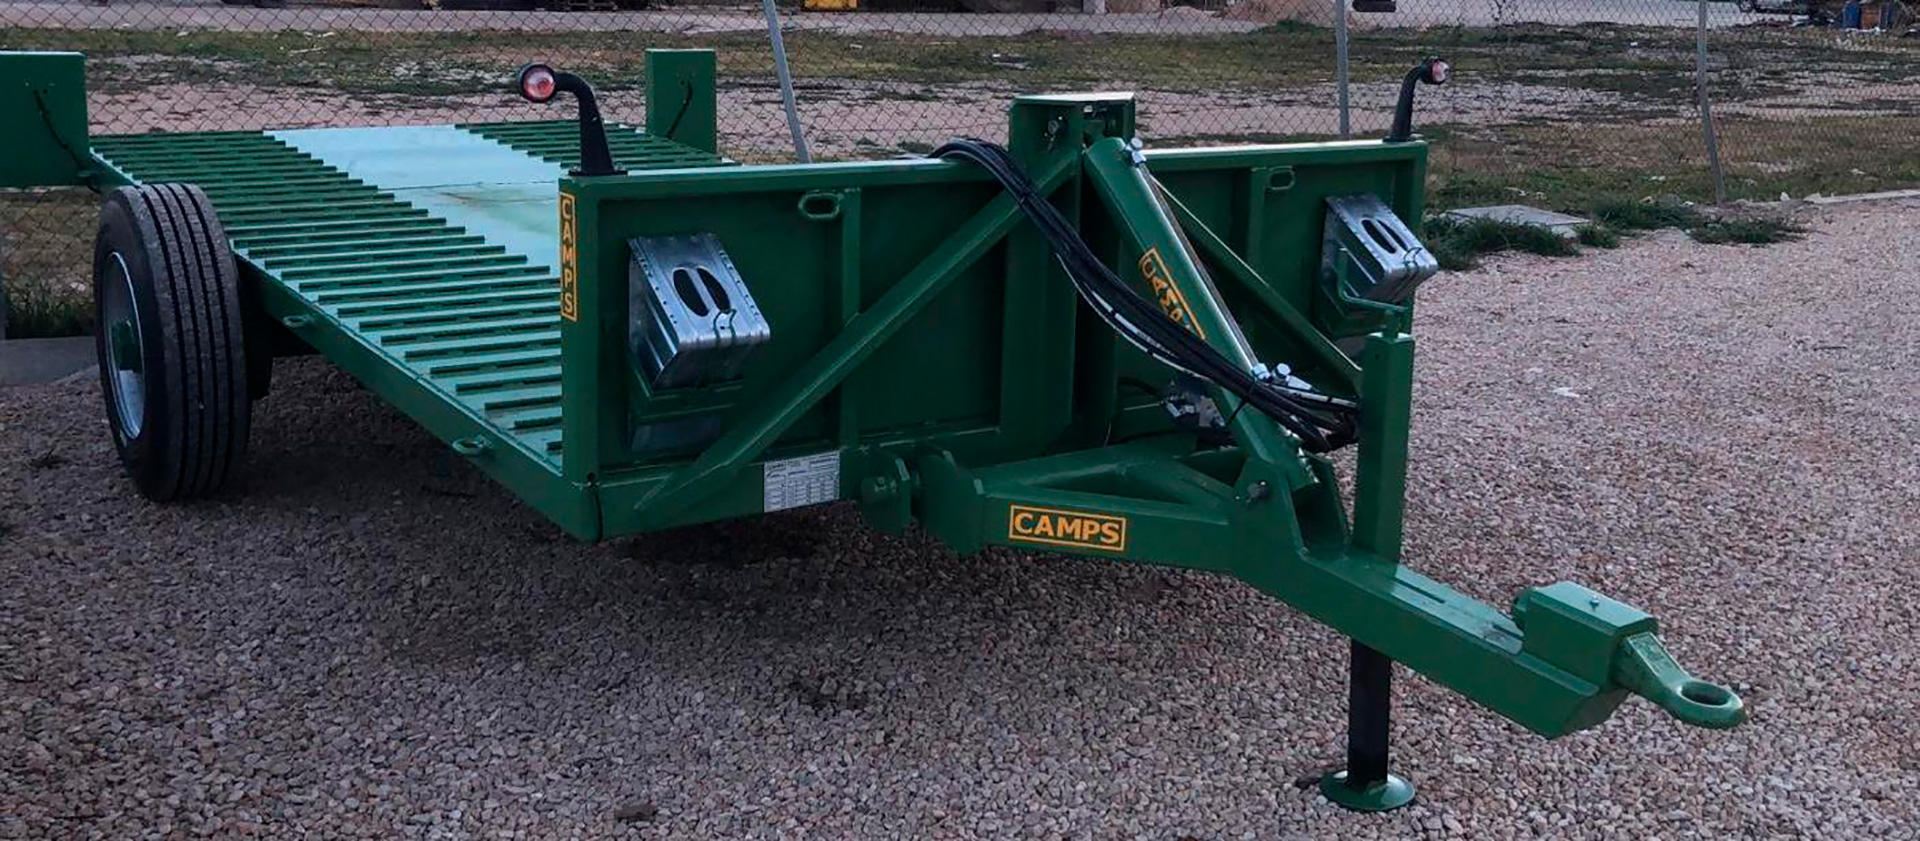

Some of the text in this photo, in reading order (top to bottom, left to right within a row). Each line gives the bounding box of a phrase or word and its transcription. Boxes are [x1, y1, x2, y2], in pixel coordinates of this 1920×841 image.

[562, 198, 574, 314] CAMPS
[1142, 257, 1190, 328] CAMP
[1014, 511, 1120, 544] CAMPS
